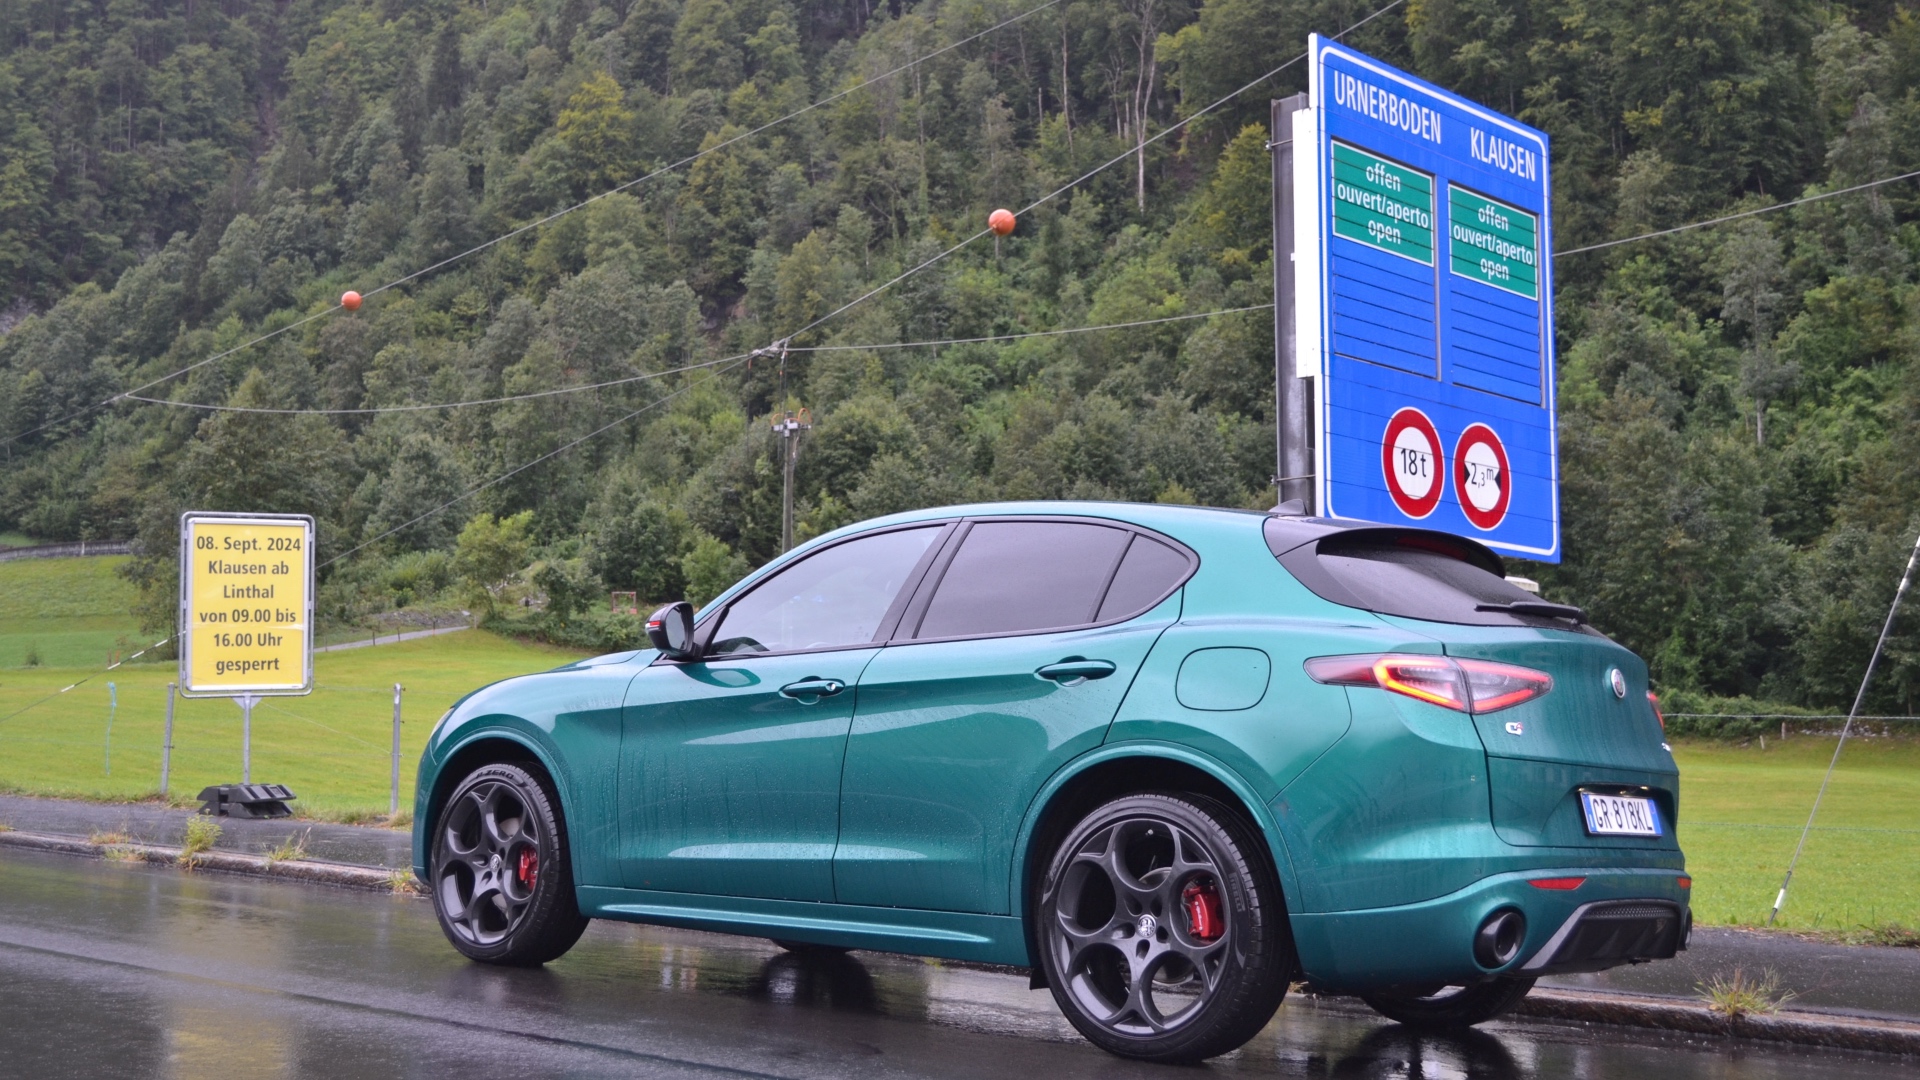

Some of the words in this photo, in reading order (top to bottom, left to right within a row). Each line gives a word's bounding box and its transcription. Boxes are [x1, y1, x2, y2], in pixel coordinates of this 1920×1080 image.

[1334, 70, 1441, 144] URNERBODEN
[1470, 127, 1536, 181] KLAUSEN
[1366, 163, 1401, 192] offen
[1337, 183, 1429, 229] ouvert/aperto
[1478, 205, 1509, 231] offen
[1368, 220, 1401, 244] open
[1453, 224, 1533, 264] ouvert/aperto
[1480, 257, 1510, 281] open
[197, 536, 218, 550] 08.
[223, 536, 262, 554] Sept.
[267, 537, 301, 551] 2024
[208, 560, 267, 575] Klausen
[271, 561, 289, 575] ab
[223, 584, 274, 599] Linthal
[199, 611, 228, 622] von
[231, 609, 271, 623] 09.00
[275, 608, 296, 623] bis
[214, 633, 252, 647] 16.00
[257, 633, 283, 647] Uhr
[216, 657, 280, 675] gesperrt
